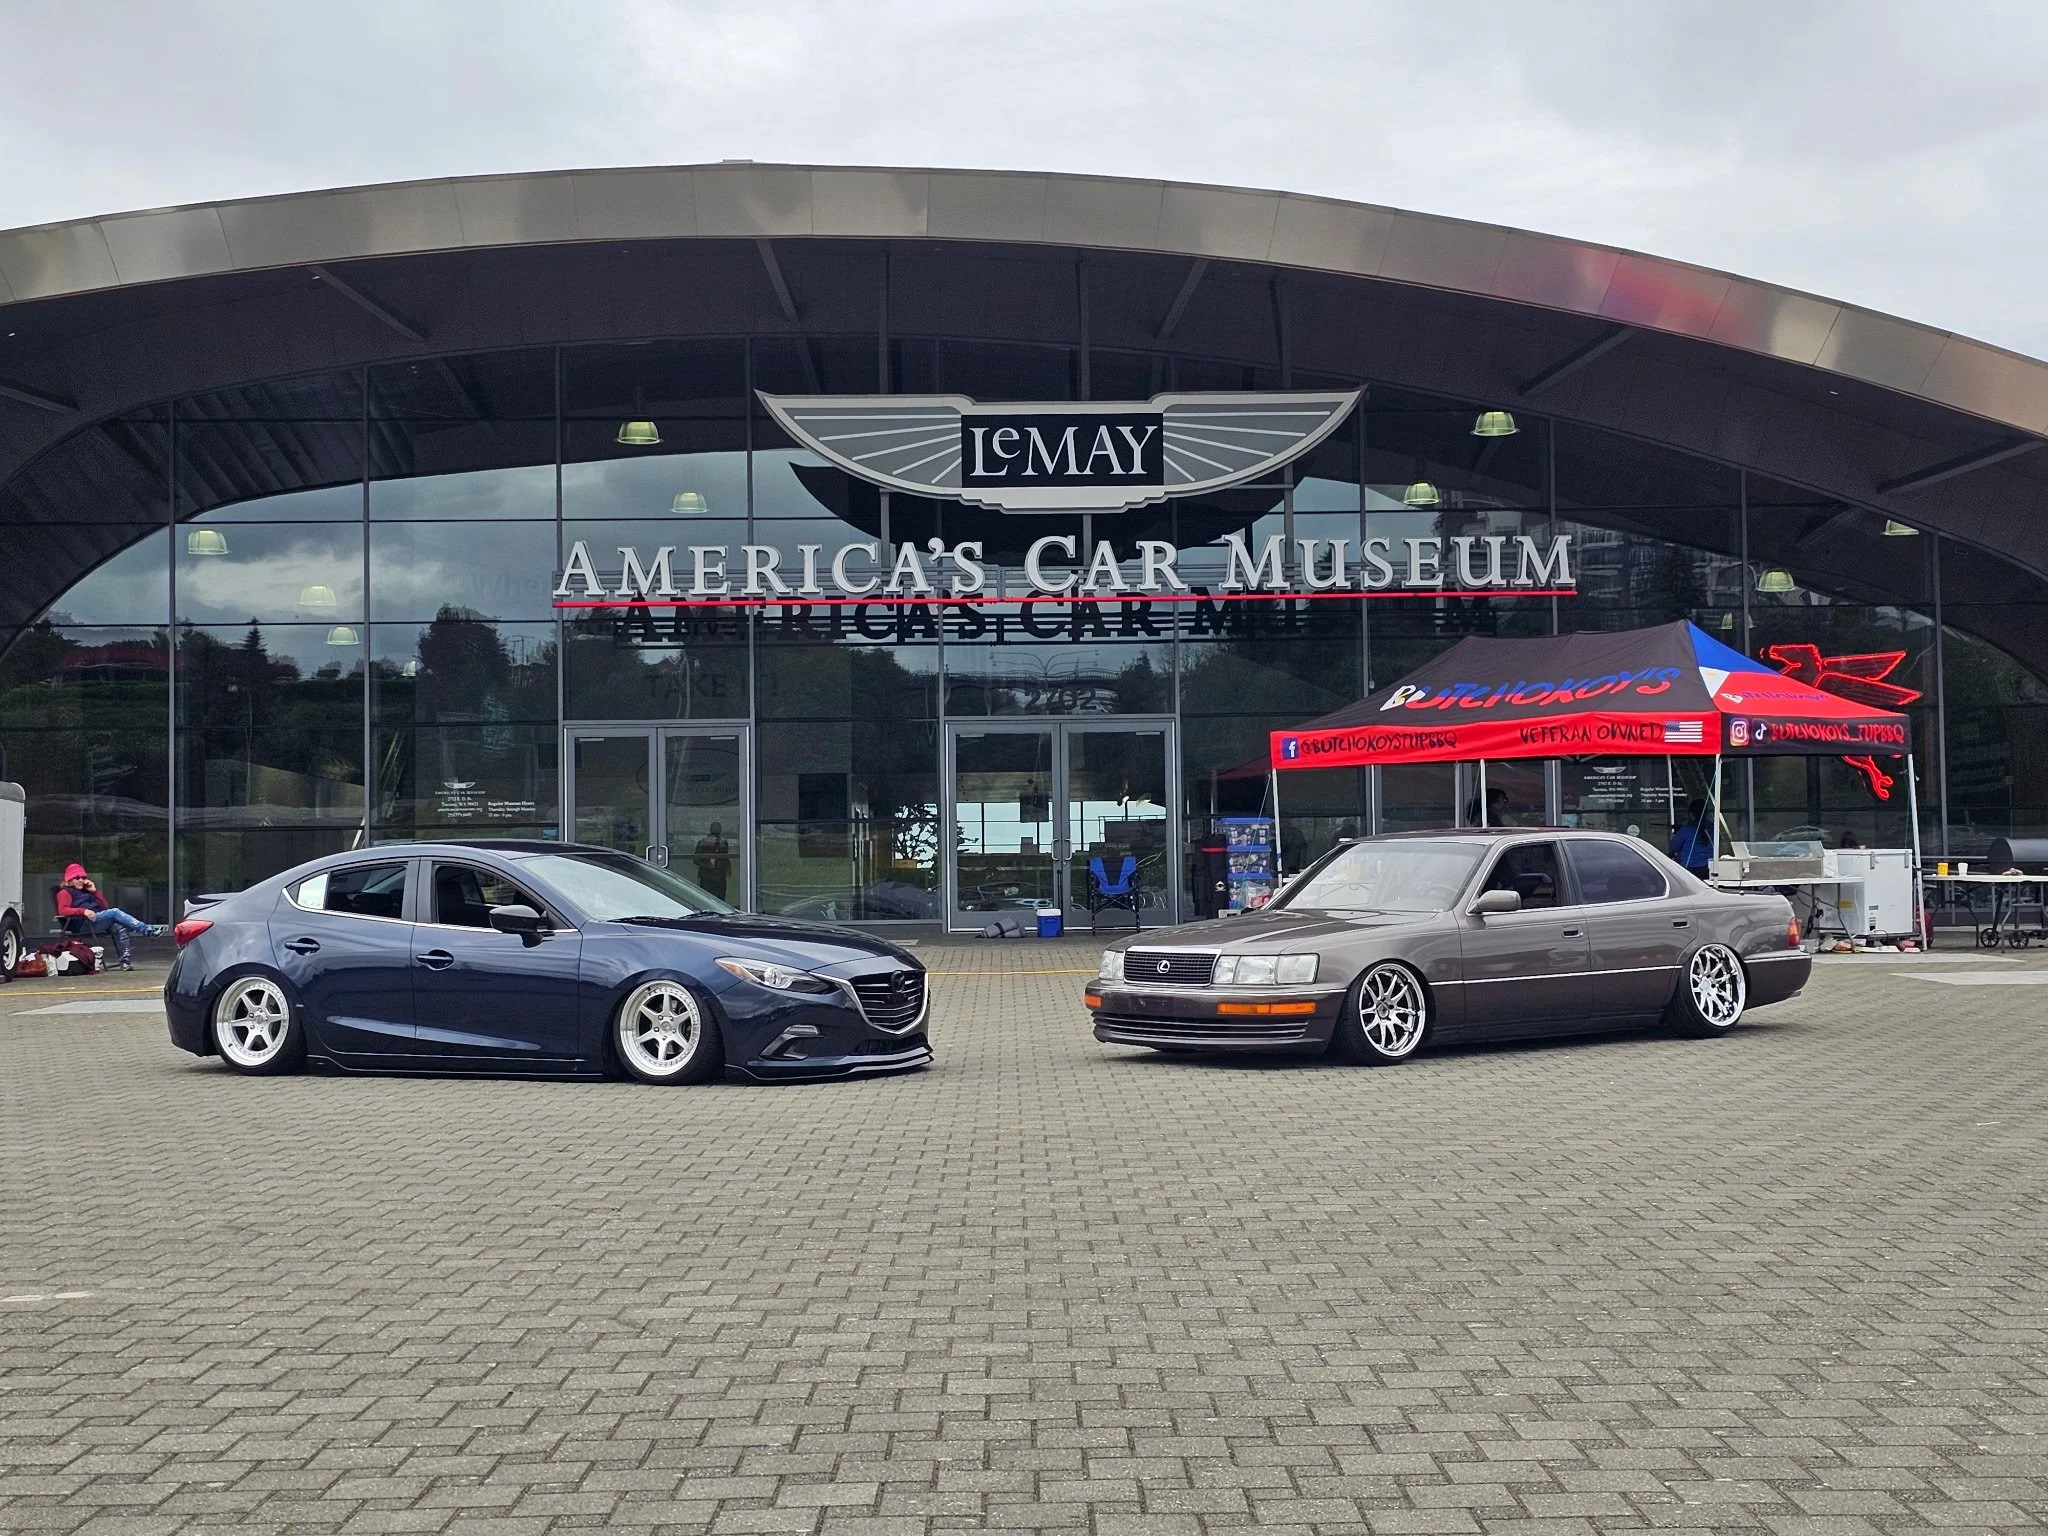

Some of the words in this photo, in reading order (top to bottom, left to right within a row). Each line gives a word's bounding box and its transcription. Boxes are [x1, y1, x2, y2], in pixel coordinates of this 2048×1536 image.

[969, 425, 1158, 476] LeMAY
[552, 536, 984, 598] AMERICA'S
[1024, 535, 1186, 593] CAR
[1220, 533, 1577, 591] MUSEUM
[1519, 724, 1592, 744] VETERAN
[1597, 722, 1664, 742] OWNED
